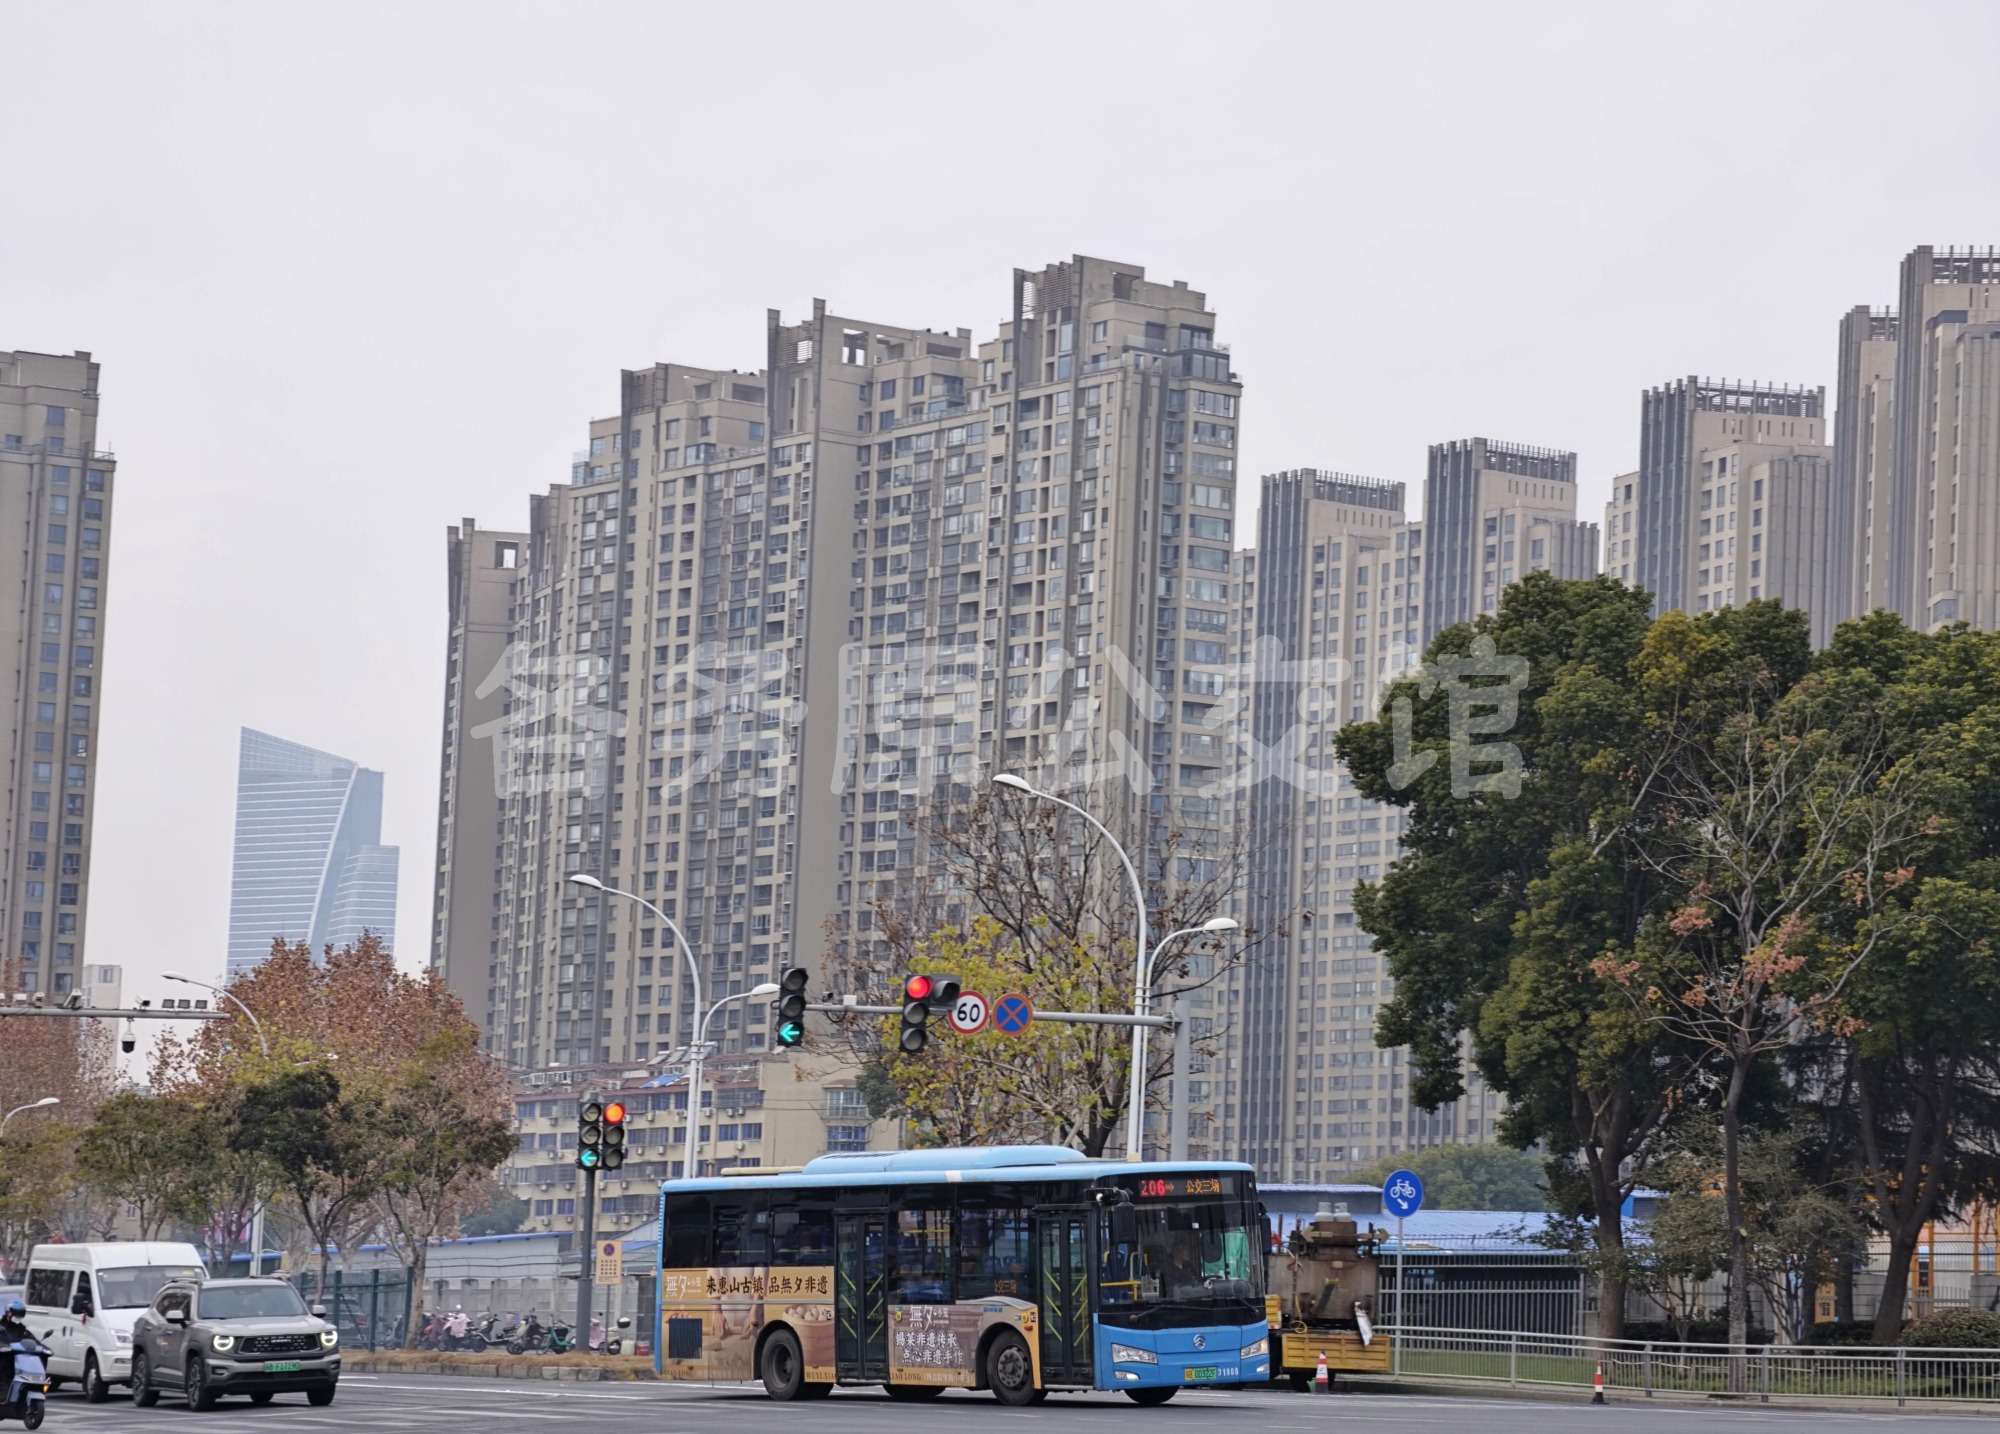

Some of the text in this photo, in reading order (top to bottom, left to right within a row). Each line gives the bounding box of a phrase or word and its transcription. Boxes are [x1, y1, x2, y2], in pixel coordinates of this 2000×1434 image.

[957, 1003, 980, 1022] 60
[1141, 1178, 1220, 1197] 206 公交三场
[706, 1275, 764, 1295] 来惠山古镇
[902, 1349, 964, 1365] 点心非遗手作
[904, 1372, 921, 1381] LONG
[1217, 1367, 1239, 1376] 31808
